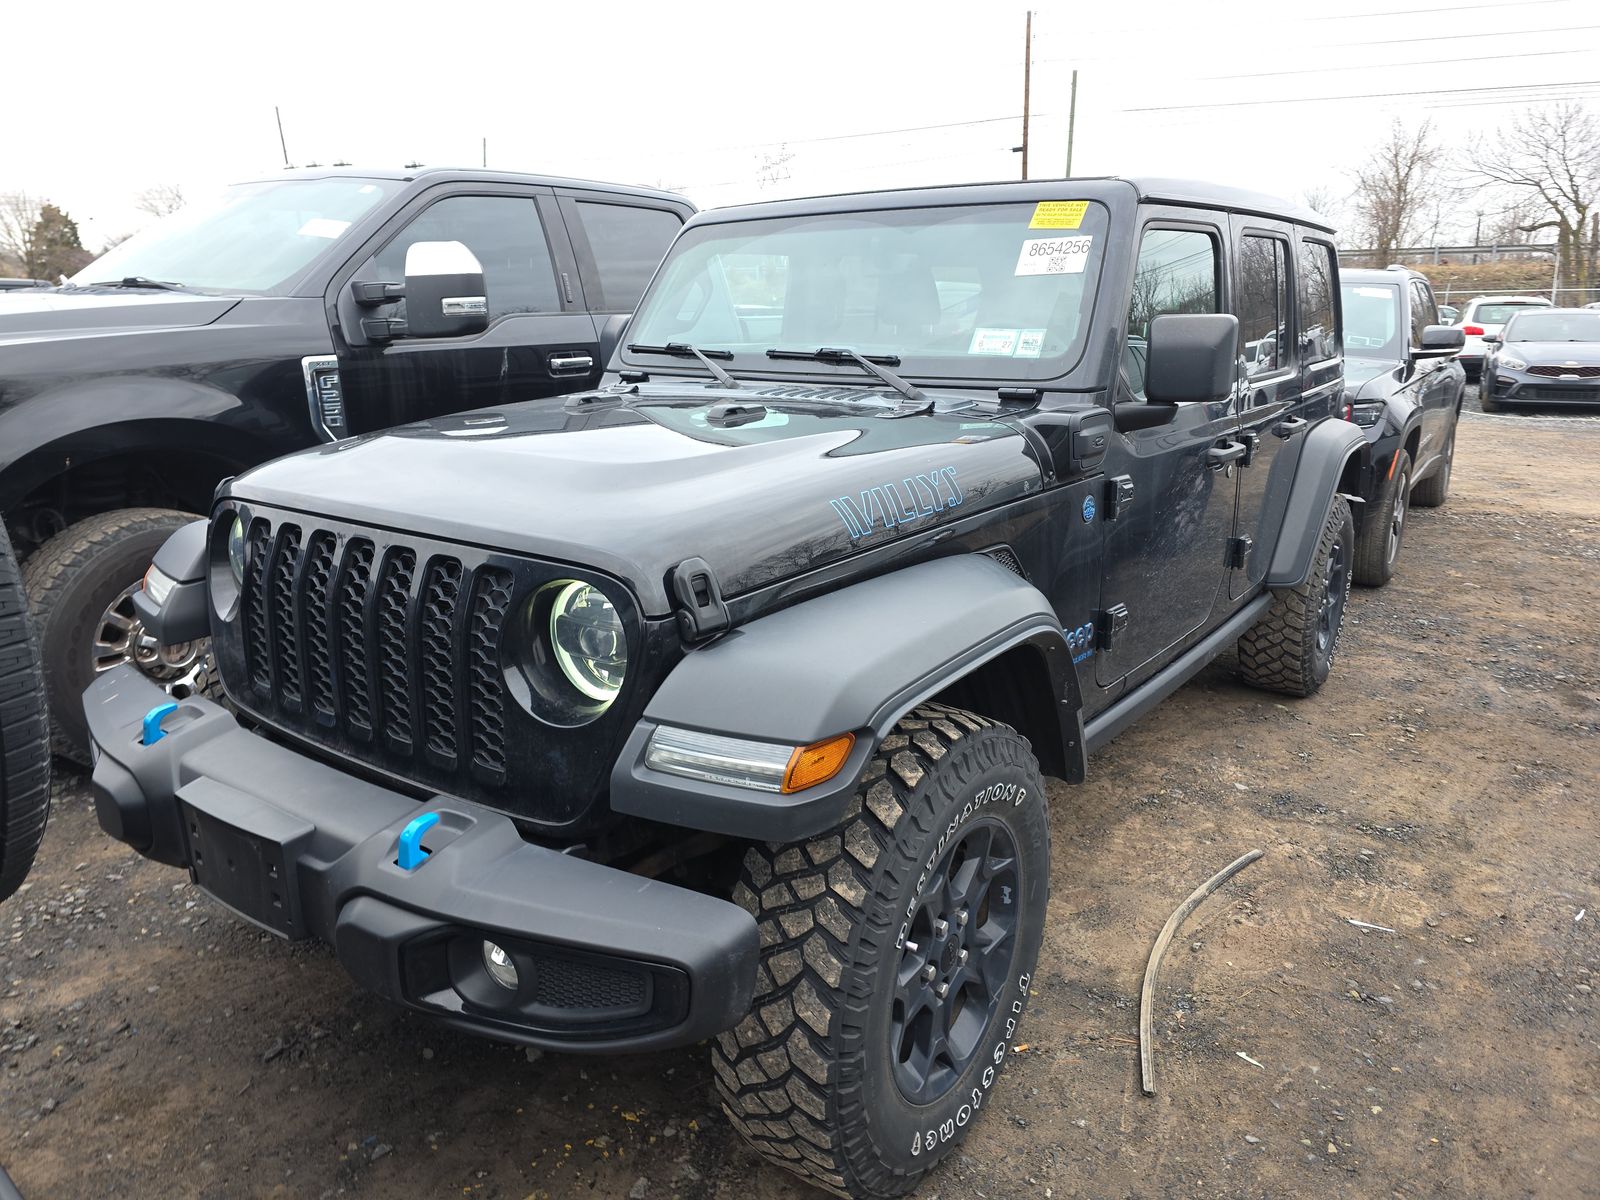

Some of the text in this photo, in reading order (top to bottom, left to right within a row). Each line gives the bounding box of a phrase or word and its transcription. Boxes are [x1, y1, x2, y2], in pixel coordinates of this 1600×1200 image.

[1029, 239, 1091, 257] 8654256
[829, 466, 964, 539] WILLYS
[1063, 622, 1094, 649] eep
[925, 972, 1031, 1151] Firestone
